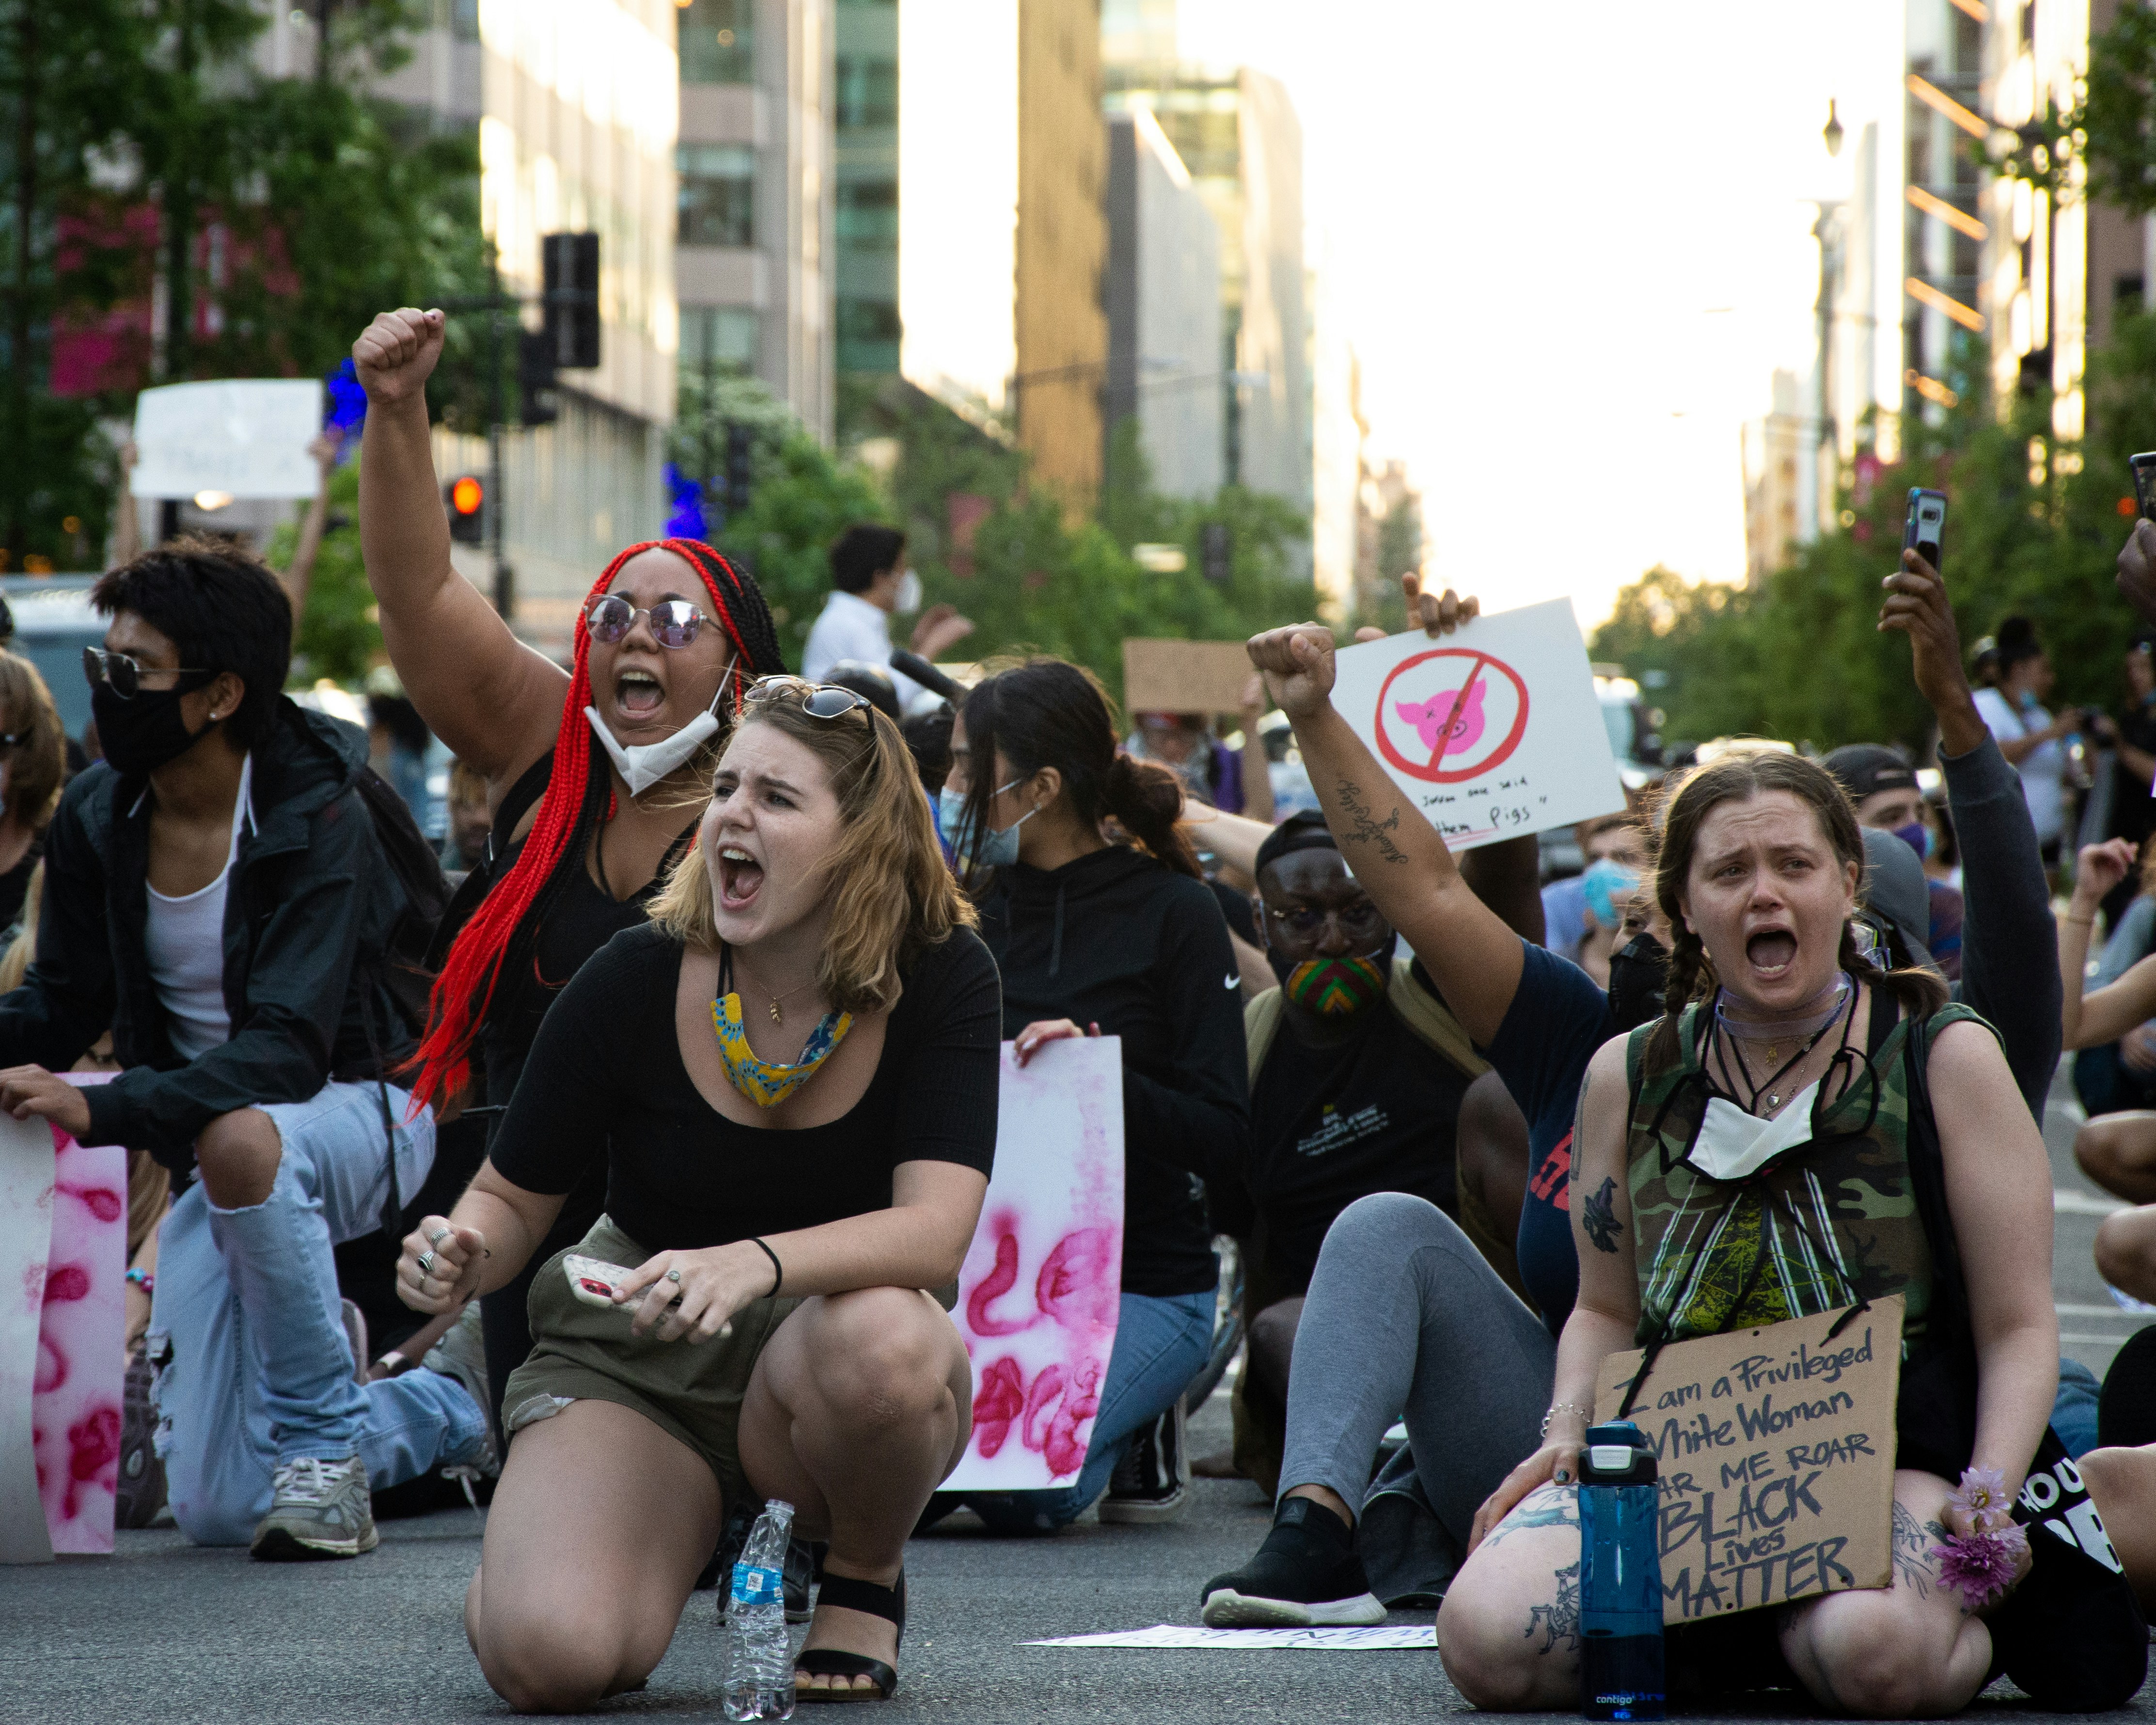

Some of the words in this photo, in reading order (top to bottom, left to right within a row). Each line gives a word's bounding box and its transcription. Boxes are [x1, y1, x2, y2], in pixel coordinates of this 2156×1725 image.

[1489, 806, 1530, 827] Pigs
[1657, 1382, 1701, 1410] am
[1711, 1376, 1733, 1399] a
[1729, 1326, 1873, 1392] Privileged
[1736, 1391, 1854, 1441] Woman
[1657, 1472, 1702, 1499] AR
[1720, 1451, 1775, 1489] ME
[1786, 1433, 1876, 1471] ROAR
[1658, 1471, 1824, 1559] BLACK
[1656, 1536, 1856, 1617] MATTER
[1704, 1526, 1786, 1573] Lives
[1596, 1695, 1633, 1706] contigo
